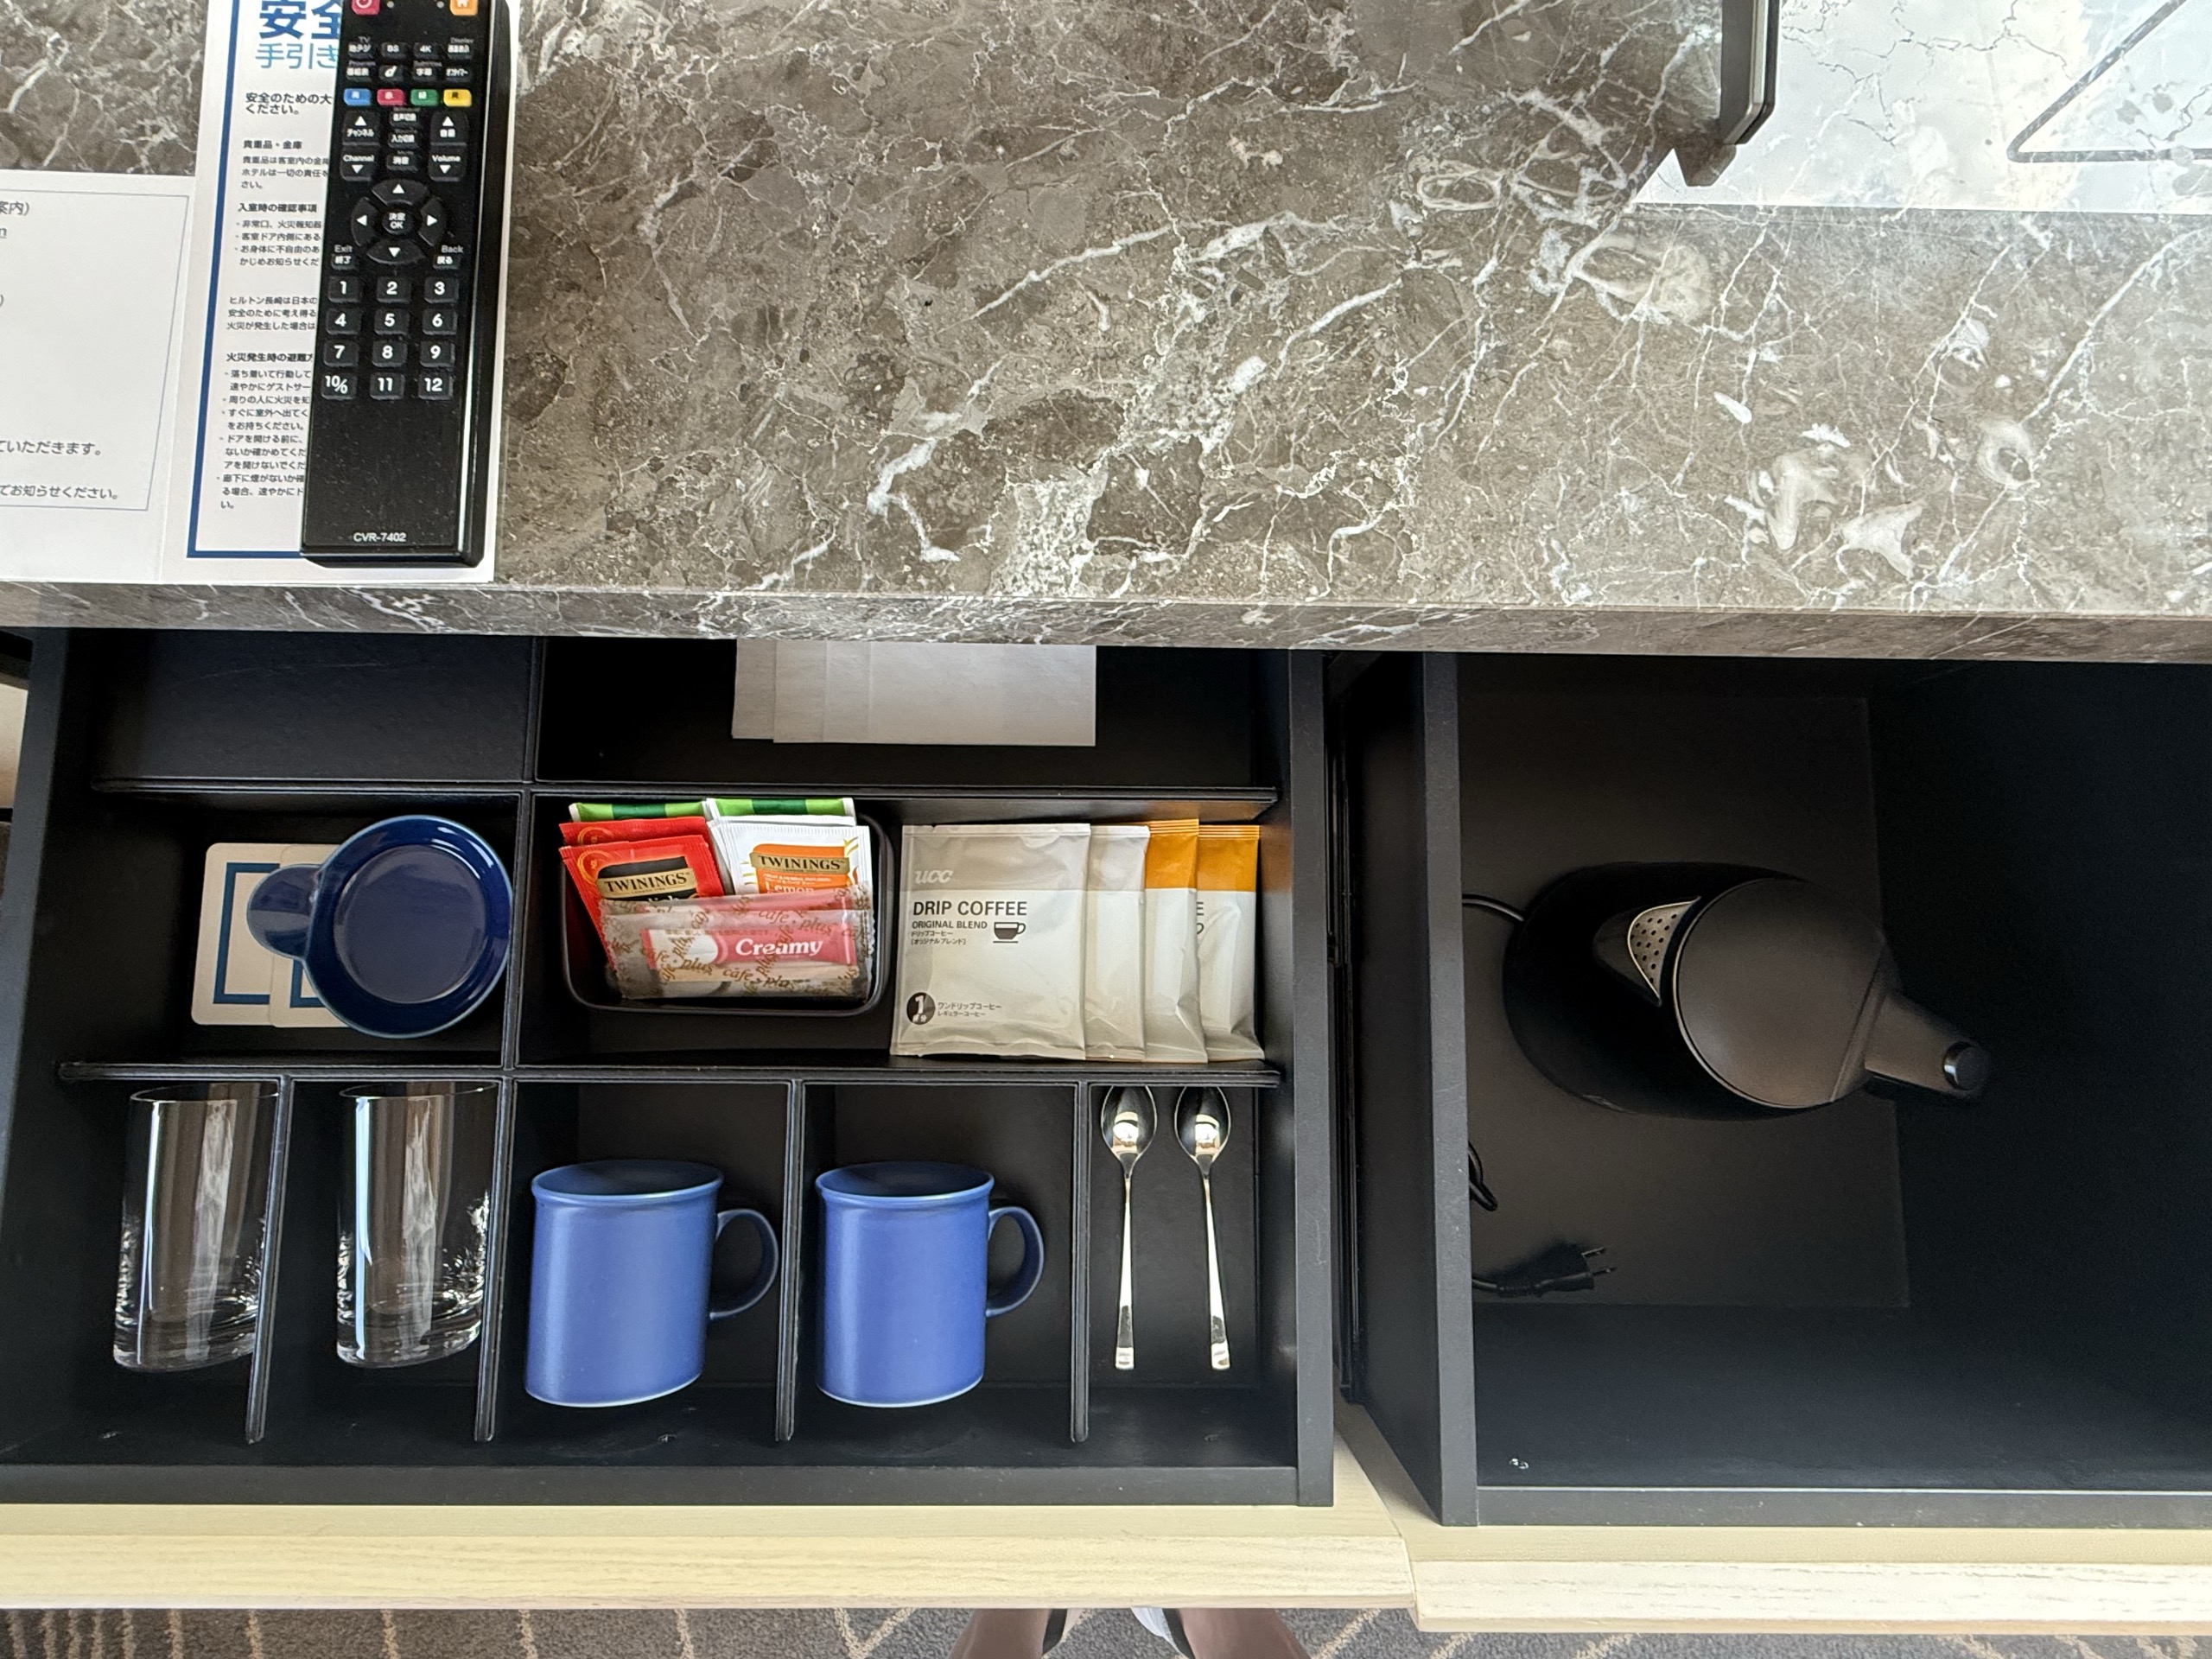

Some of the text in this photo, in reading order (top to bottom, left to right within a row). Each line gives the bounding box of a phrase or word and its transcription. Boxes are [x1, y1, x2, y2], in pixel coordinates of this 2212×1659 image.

[255, 42, 337, 69] 手引き
[386, 44, 400, 53] BS
[245, 92, 333, 105] 安全のための大
[246, 103, 300, 115] ください。
[334, 245, 353, 253] Exit
[340, 281, 347, 295] 1
[386, 281, 397, 296] 2
[434, 281, 445, 296] 3
[334, 313, 347, 327] 4
[384, 313, 396, 327] 5
[432, 313, 443, 327] 6
[334, 345, 346, 359] 7
[381, 345, 393, 359] 8
[429, 345, 442, 359] 9
[378, 378, 393, 391] 11
[423, 378, 443, 391] 12
[353, 531, 407, 542] CVR-7402
[757, 855, 841, 871] TWININGS
[605, 871, 688, 893] TWININGS
[912, 900, 1027, 916] DRIP COFFEE
[912, 920, 988, 929] ORIGINAL BLEND
[734, 938, 823, 957] Creamy
[938, 1001, 1002, 1010] ワンドリップコーヒー
